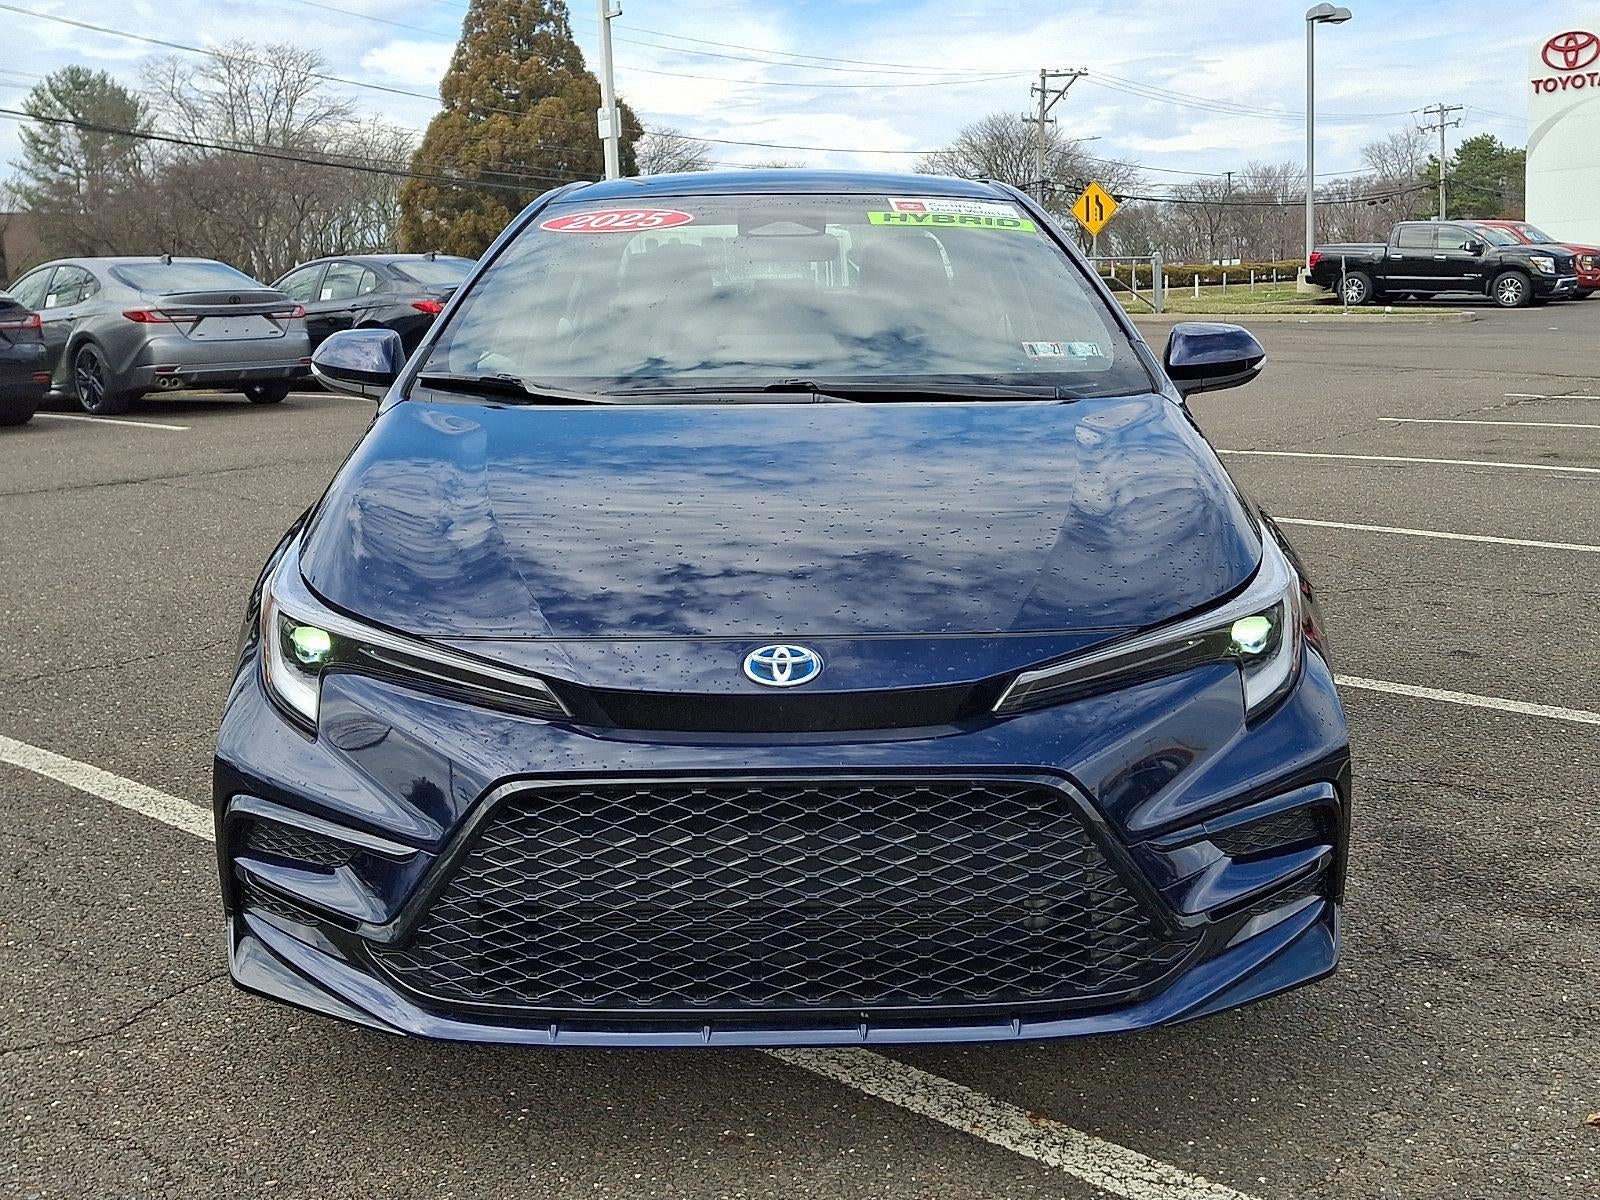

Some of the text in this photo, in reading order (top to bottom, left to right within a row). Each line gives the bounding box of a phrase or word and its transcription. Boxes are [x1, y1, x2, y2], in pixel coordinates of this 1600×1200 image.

[1531, 72, 1600, 94] TOYOT
[560, 212, 673, 230] 2025
[883, 213, 1021, 227] HYBRID
